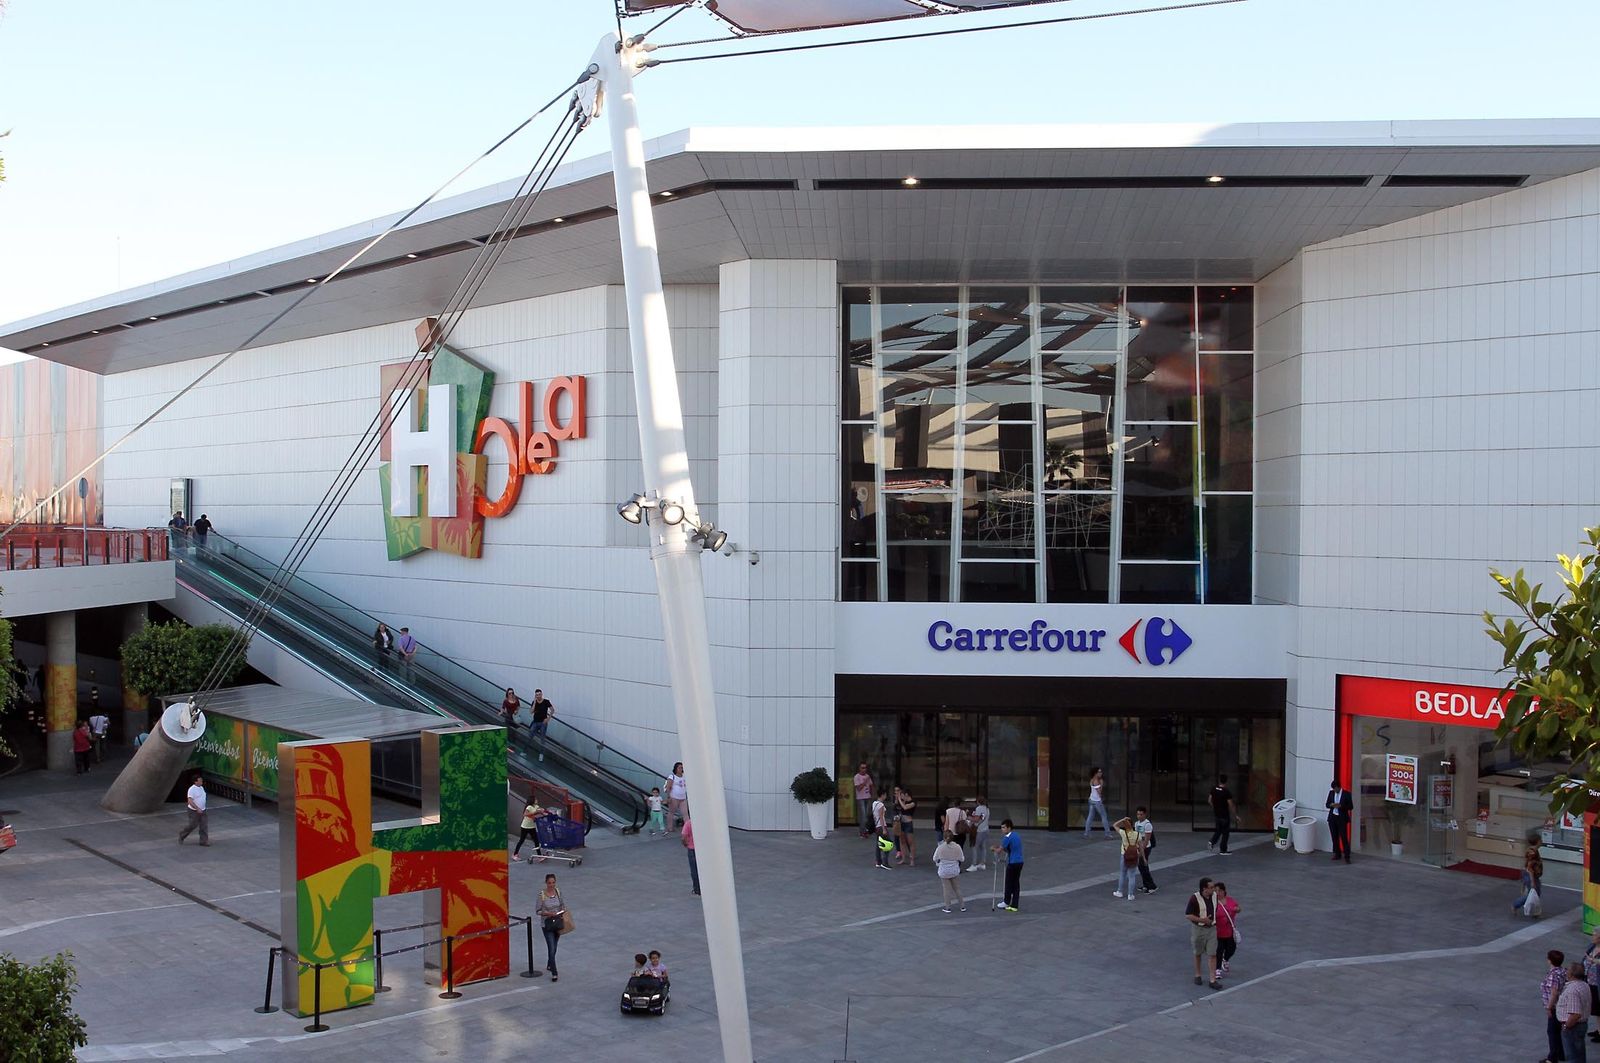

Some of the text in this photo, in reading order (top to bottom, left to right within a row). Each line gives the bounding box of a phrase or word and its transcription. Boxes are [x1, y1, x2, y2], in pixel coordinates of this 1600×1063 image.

[928, 619, 1106, 653] Carrefour
[1415, 690, 1540, 721] BEDLA
[1392, 770, 1414, 780] 300€
